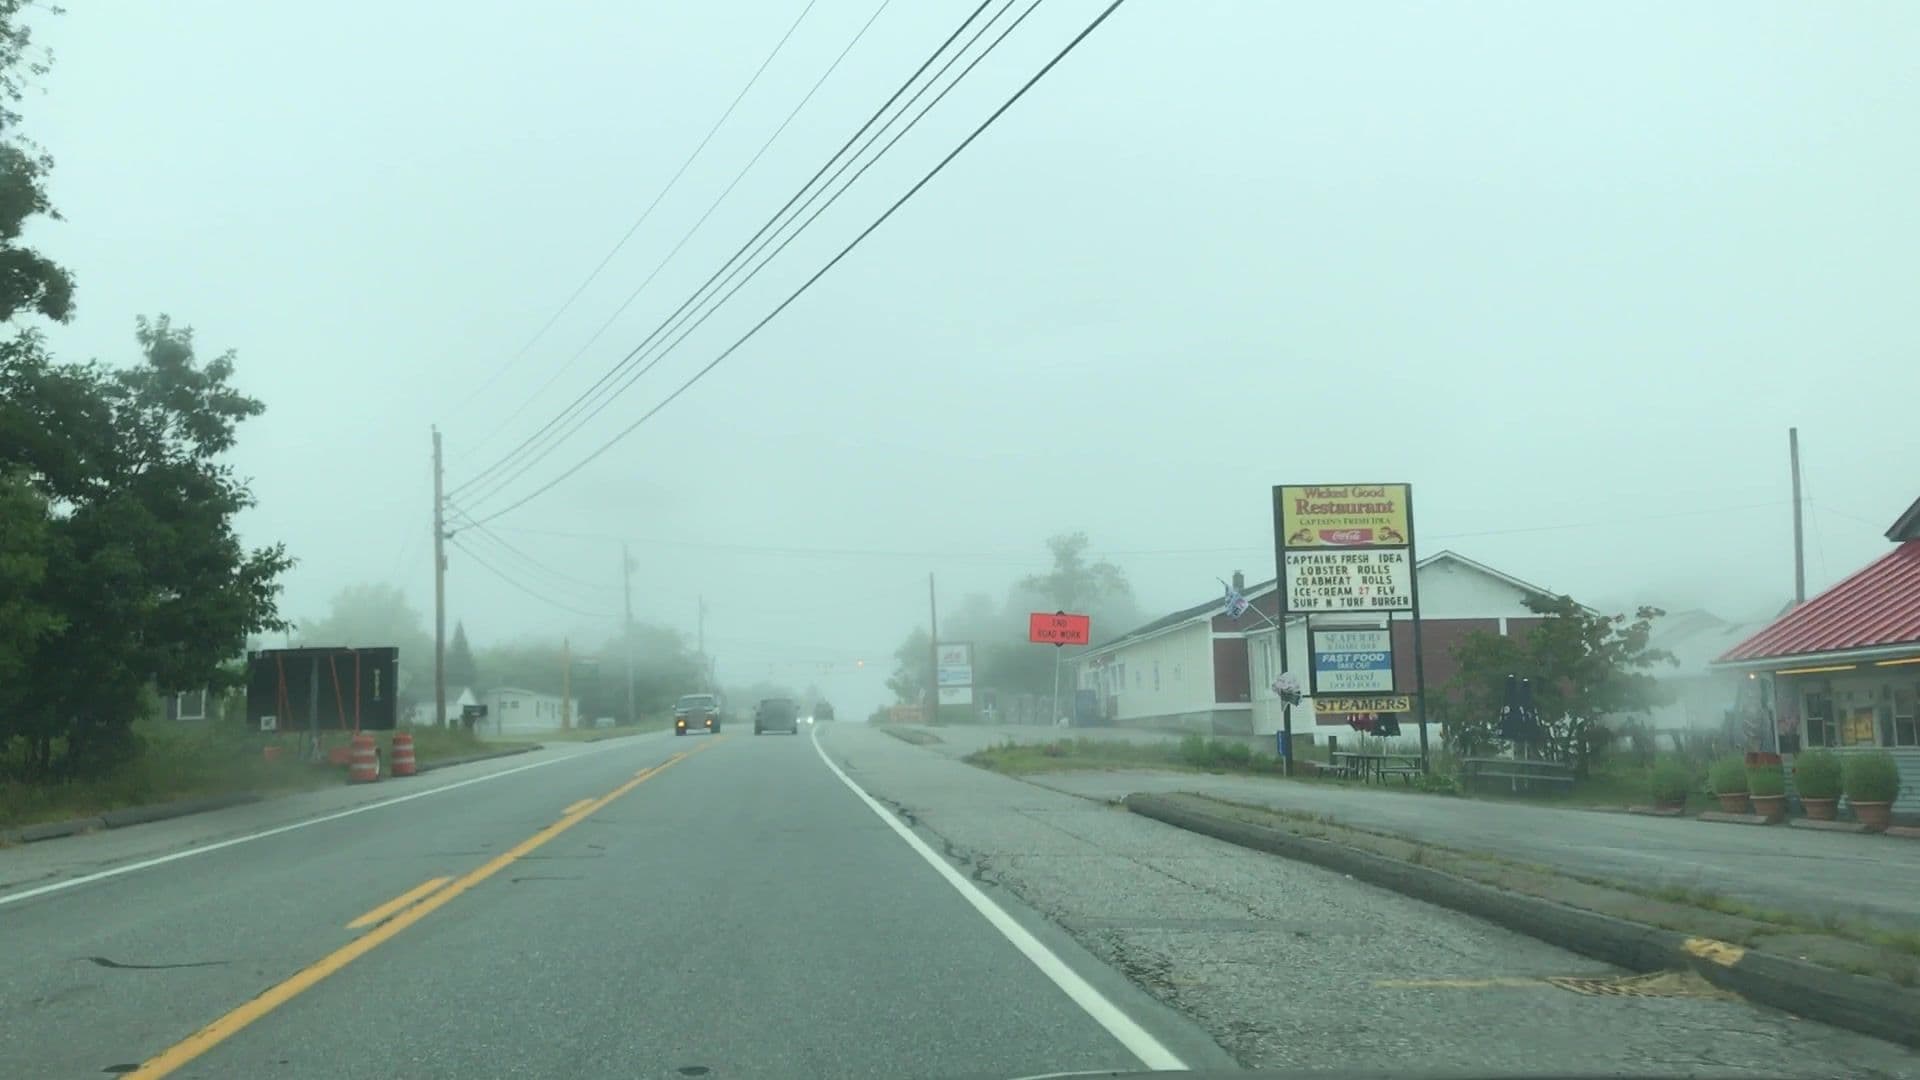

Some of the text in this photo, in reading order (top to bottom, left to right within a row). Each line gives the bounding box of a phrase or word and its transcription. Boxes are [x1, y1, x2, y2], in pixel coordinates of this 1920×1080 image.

[1352, 487, 1385, 498] Good
[1296, 499, 1395, 515] Restaurant
[1287, 553, 1403, 565] CAPTAINS FRESH IDEA
[1301, 565, 1390, 576] LOBSTER ROLLS
[1296, 575, 1392, 587] CRABMEAT ROLLS
[1295, 586, 1352, 596] ICE-CREAM
[1293, 596, 1408, 608] SURF N TURF BURGER
[1322, 653, 1385, 662] FAST FOOD
[1315, 698, 1407, 711] STEAMERS
